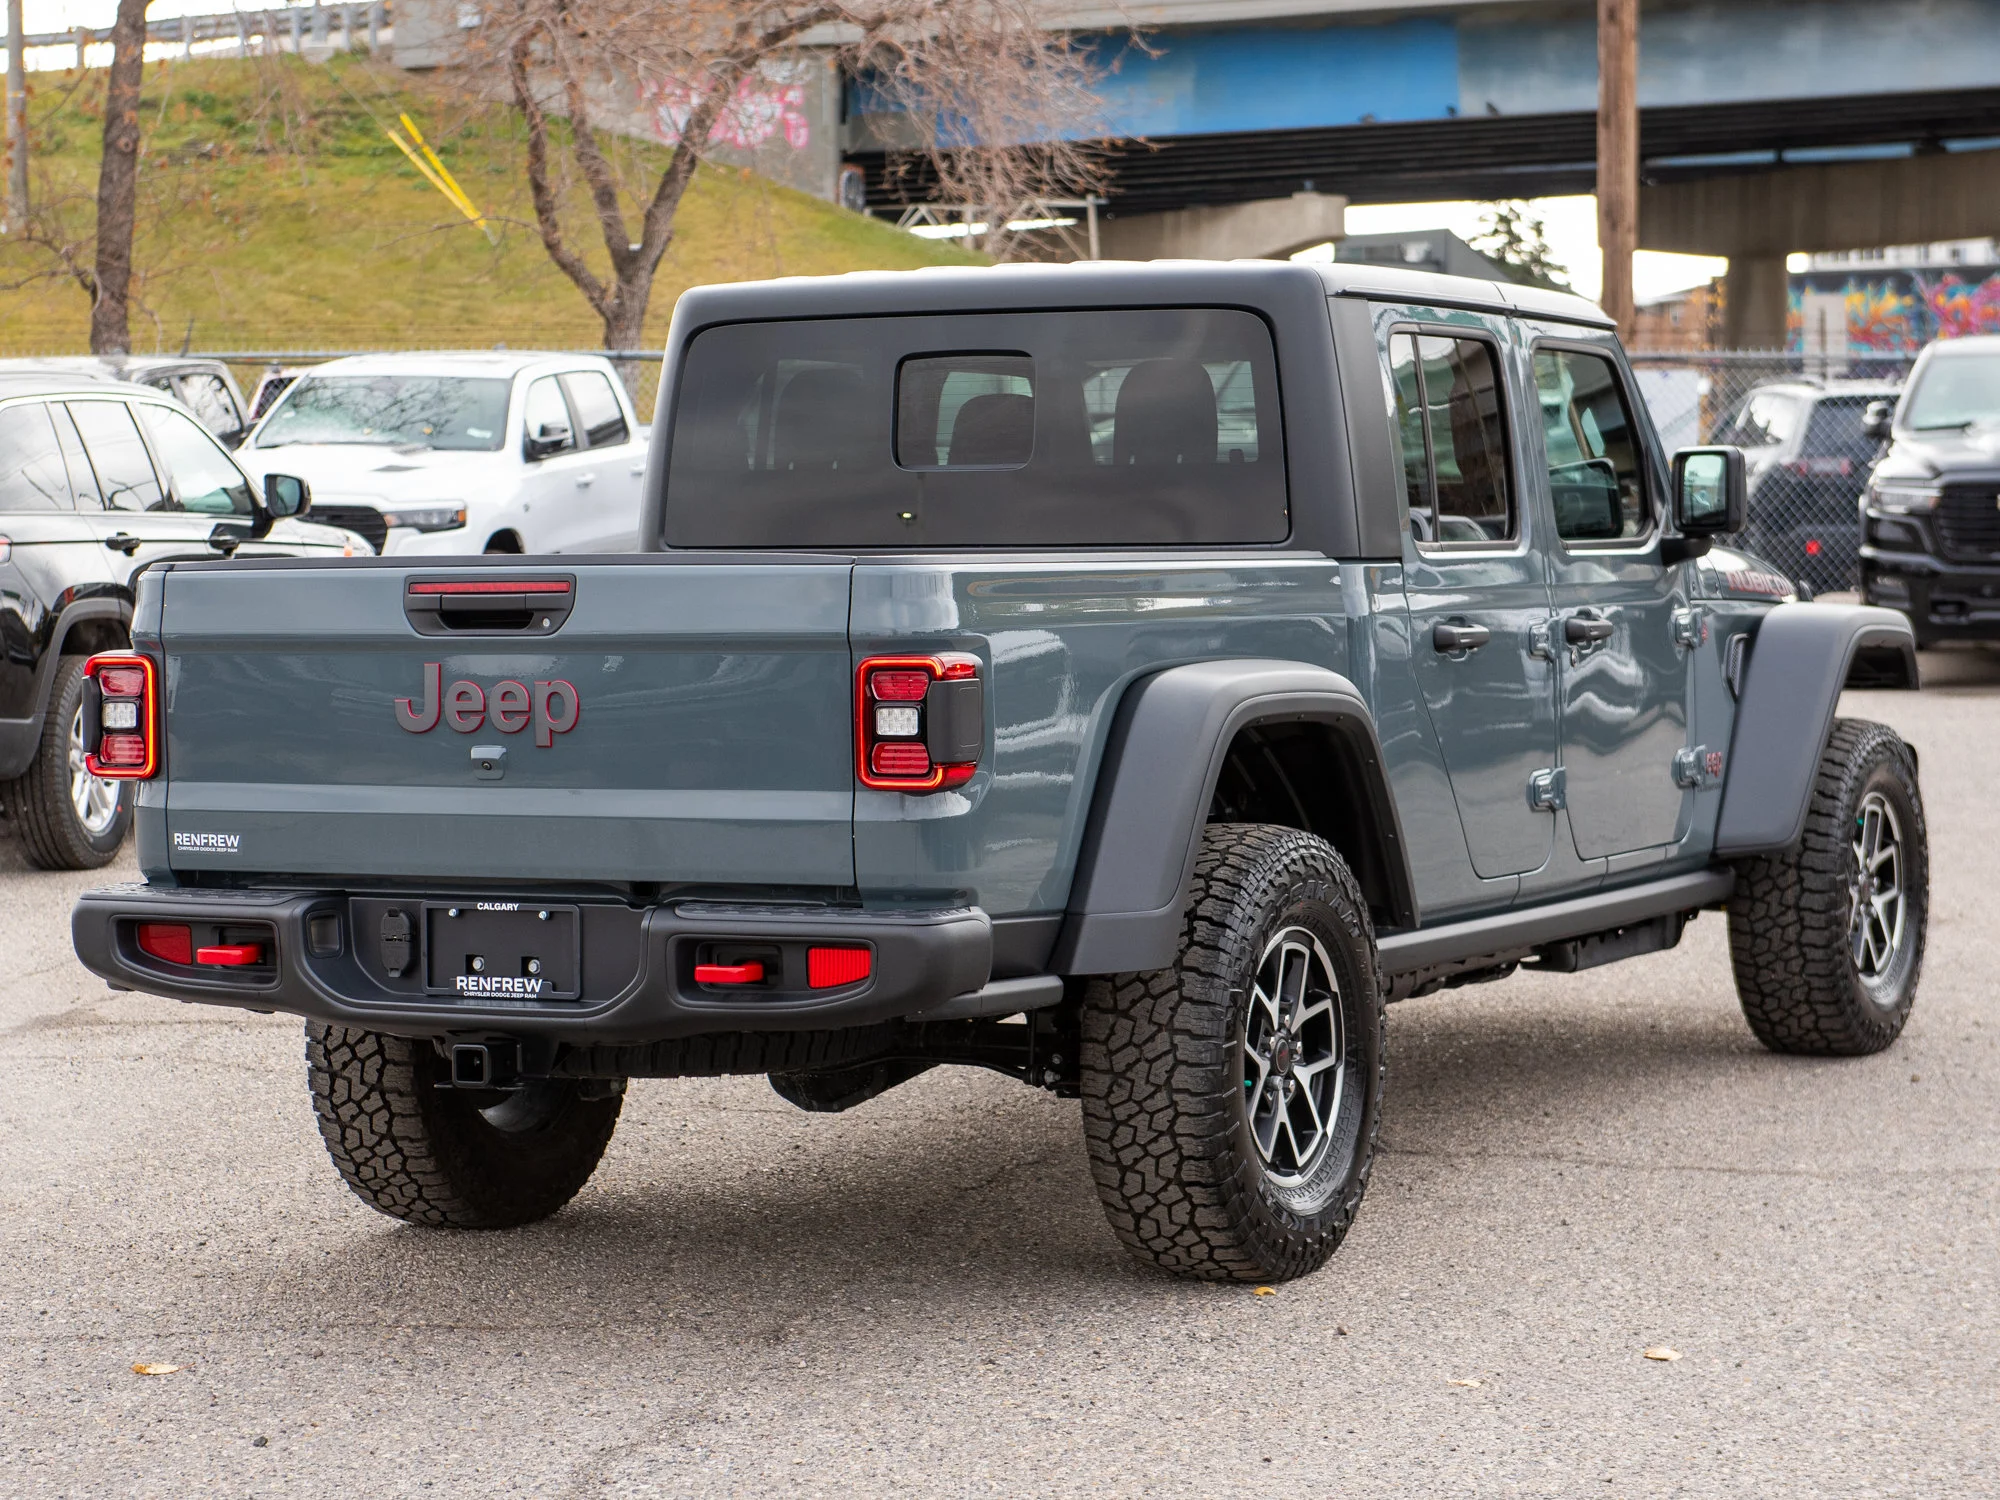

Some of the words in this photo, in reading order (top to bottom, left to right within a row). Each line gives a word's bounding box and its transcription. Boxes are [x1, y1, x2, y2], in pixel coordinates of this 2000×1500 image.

[394, 662, 580, 748] Jeep
[174, 832, 240, 848] RENFREW
[477, 902, 520, 911] CALGARY
[456, 976, 543, 993] RENFREW
